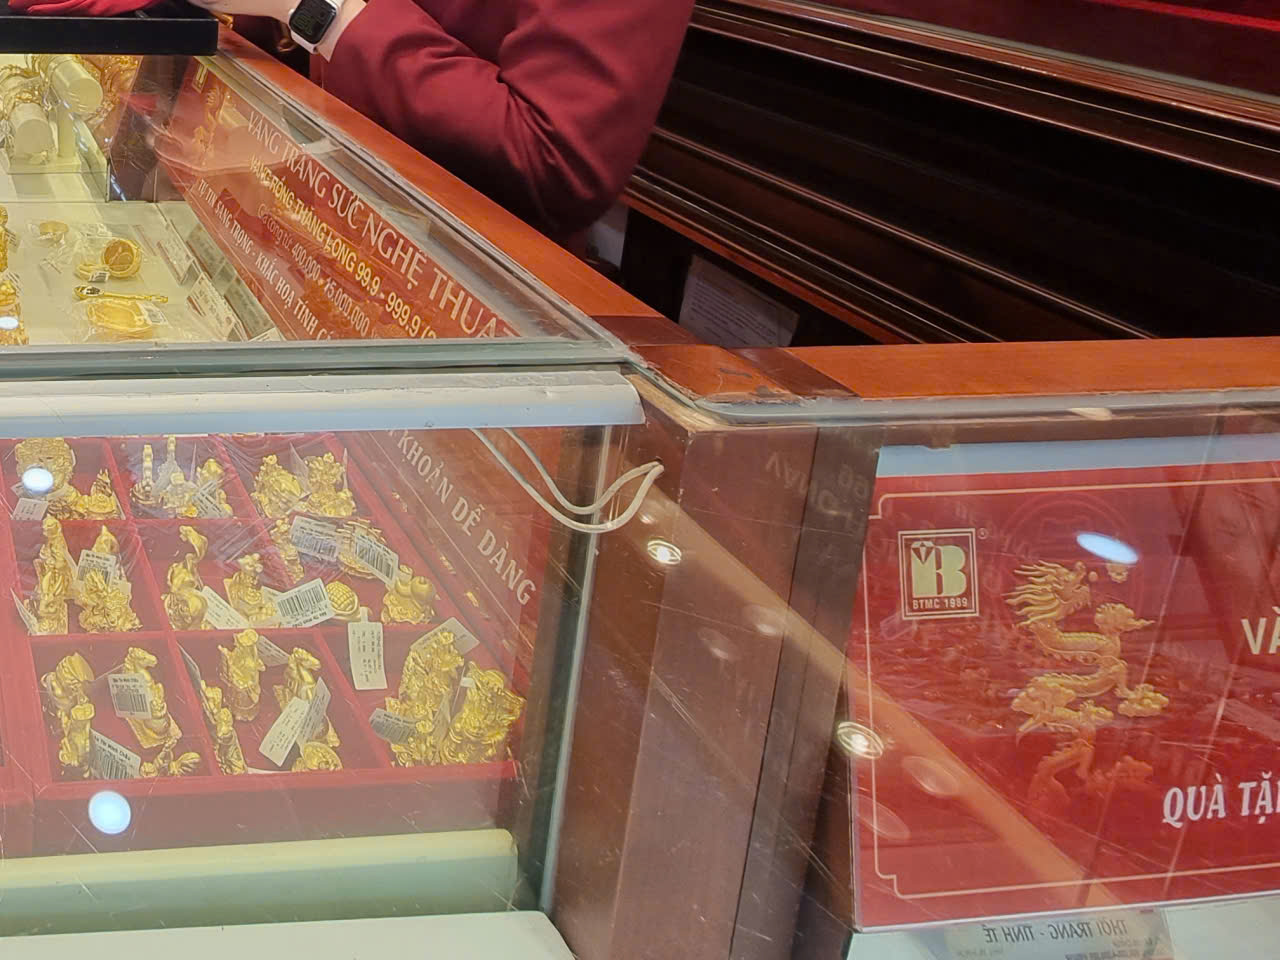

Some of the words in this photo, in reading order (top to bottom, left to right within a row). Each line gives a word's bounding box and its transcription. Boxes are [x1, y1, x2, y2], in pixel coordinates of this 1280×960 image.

[247, 111, 282, 154] VÀNG
[281, 141, 330, 198] TRANG
[328, 183, 365, 230] SỨC
[362, 213, 428, 290] NGHỆ
[293, 297, 319, 336] TÍNH
[325, 232, 357, 273] LONG
[355, 261, 381, 296] 99.9
[385, 292, 421, 337] 999.9
[397, 429, 453, 505] KHOẢN
[451, 496, 485, 536] DỄ
[477, 529, 537, 606] DÀNG
[912, 598, 940, 610] BTMC
[944, 597, 968, 608] 1989
[1162, 772, 1226, 829] QUÀ
[1238, 770, 1280, 824] TẶ
